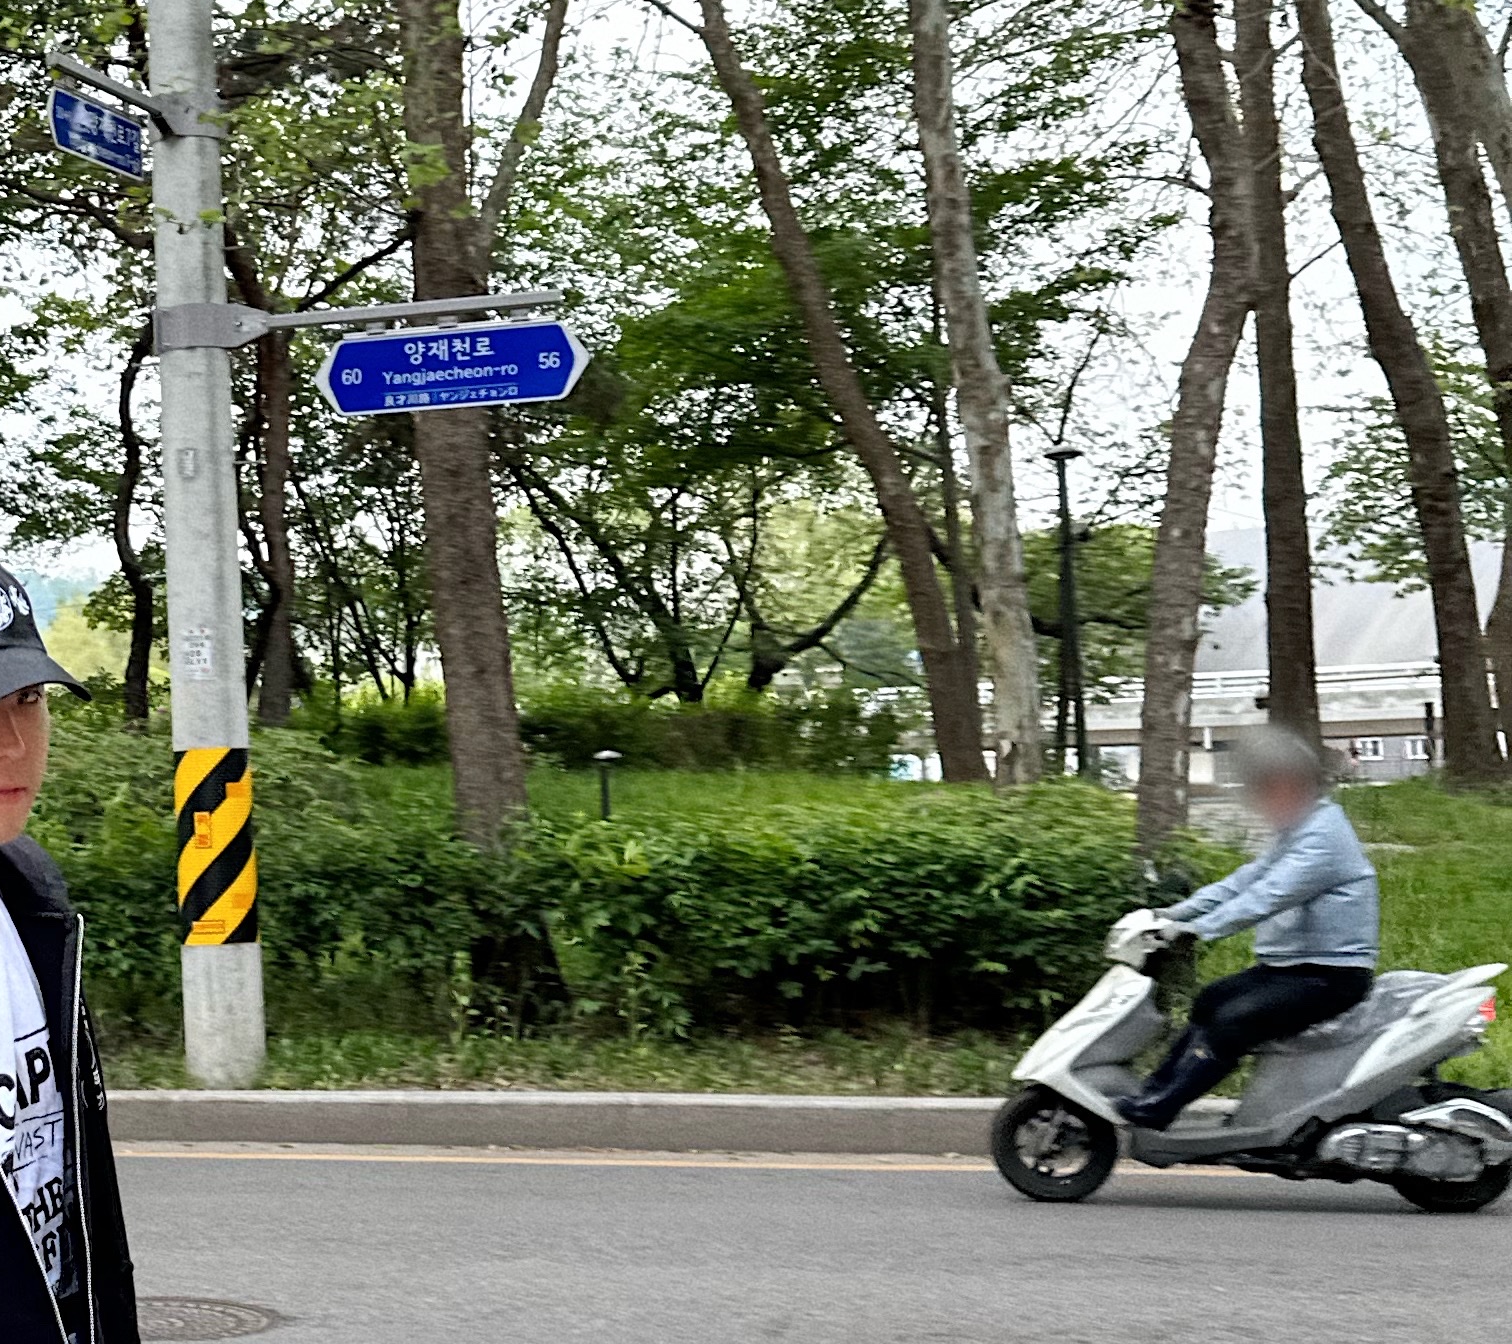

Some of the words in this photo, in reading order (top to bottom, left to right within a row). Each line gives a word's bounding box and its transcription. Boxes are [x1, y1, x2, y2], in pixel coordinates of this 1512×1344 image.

[404, 336, 495, 365] 양재천로
[538, 352, 561, 369] 56
[341, 368, 363, 385] 60
[383, 363, 519, 386] Yangjaecheon-ro
